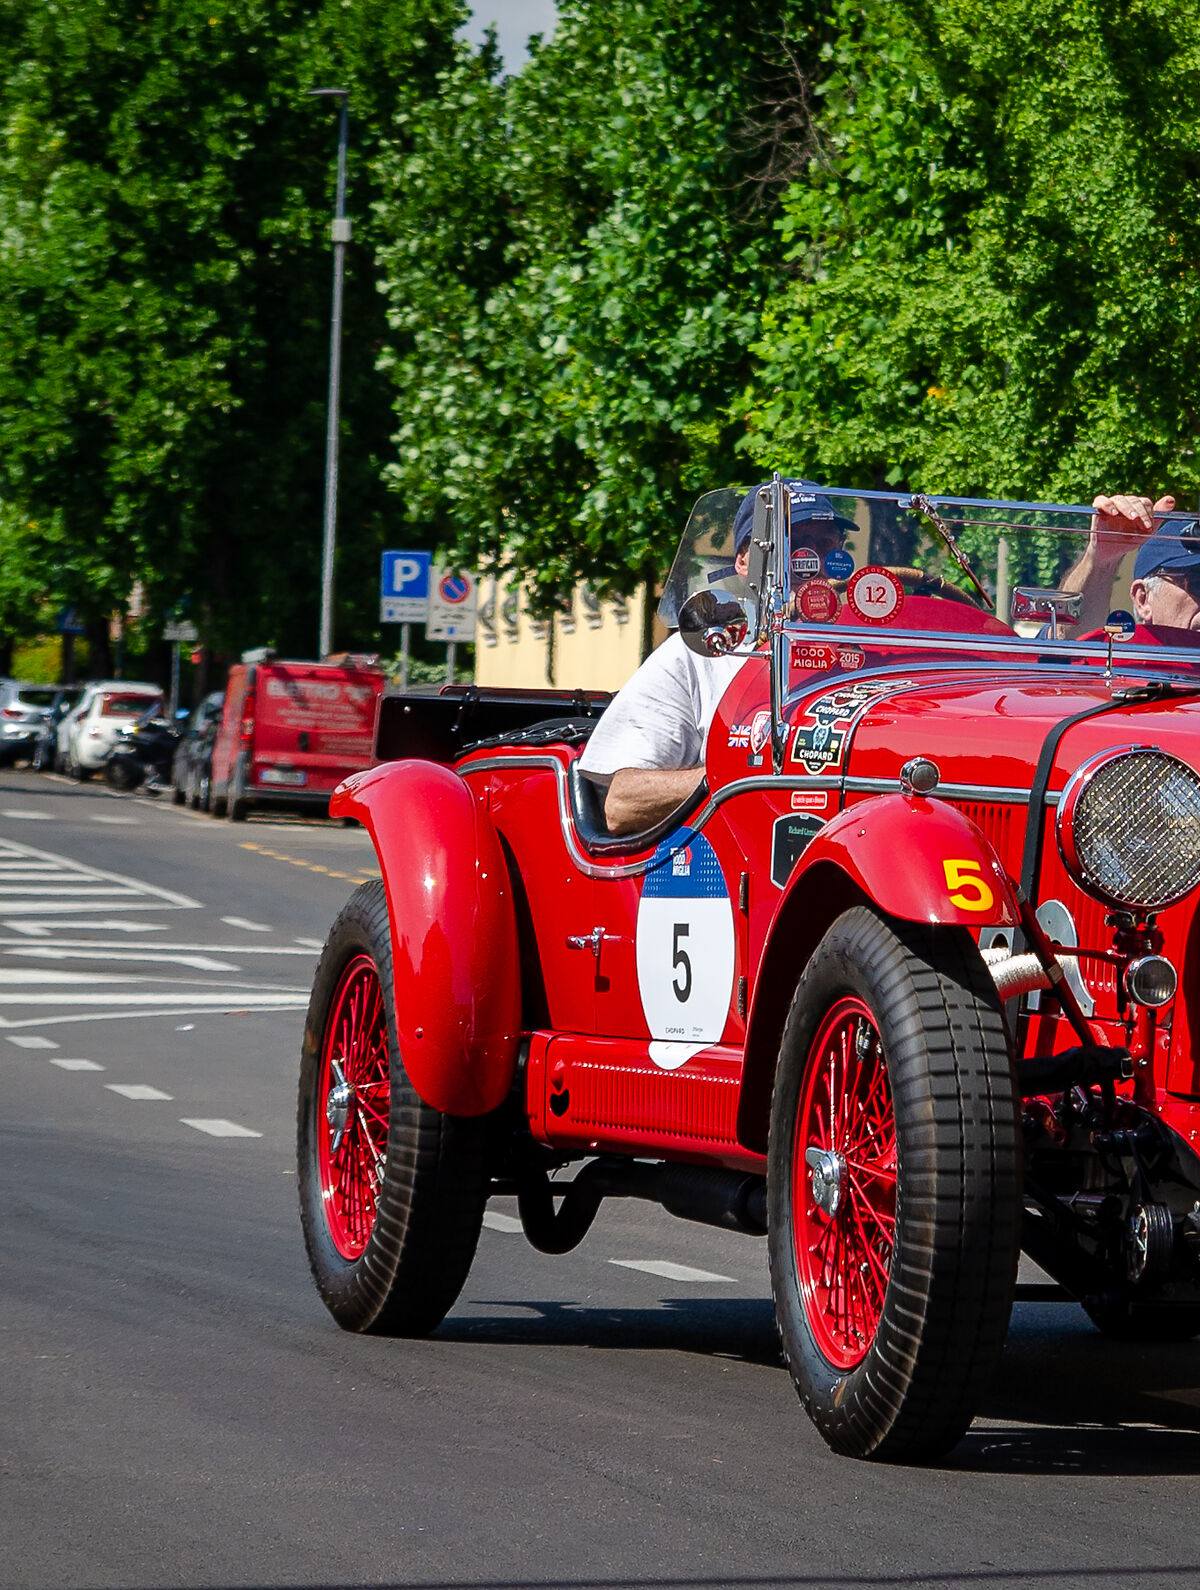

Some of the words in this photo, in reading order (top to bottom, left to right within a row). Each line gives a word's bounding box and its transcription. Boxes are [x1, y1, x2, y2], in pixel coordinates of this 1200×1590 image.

[393, 558, 420, 592] P
[865, 586, 887, 604] 12
[795, 648, 825, 658] 1000
[840, 652, 860, 663] 2015
[793, 658, 828, 669] MIGLIA
[815, 705, 850, 717] CHOPARD
[799, 748, 834, 761] CHOPARD
[942, 859, 994, 912] 5
[672, 923, 692, 1003] 5
